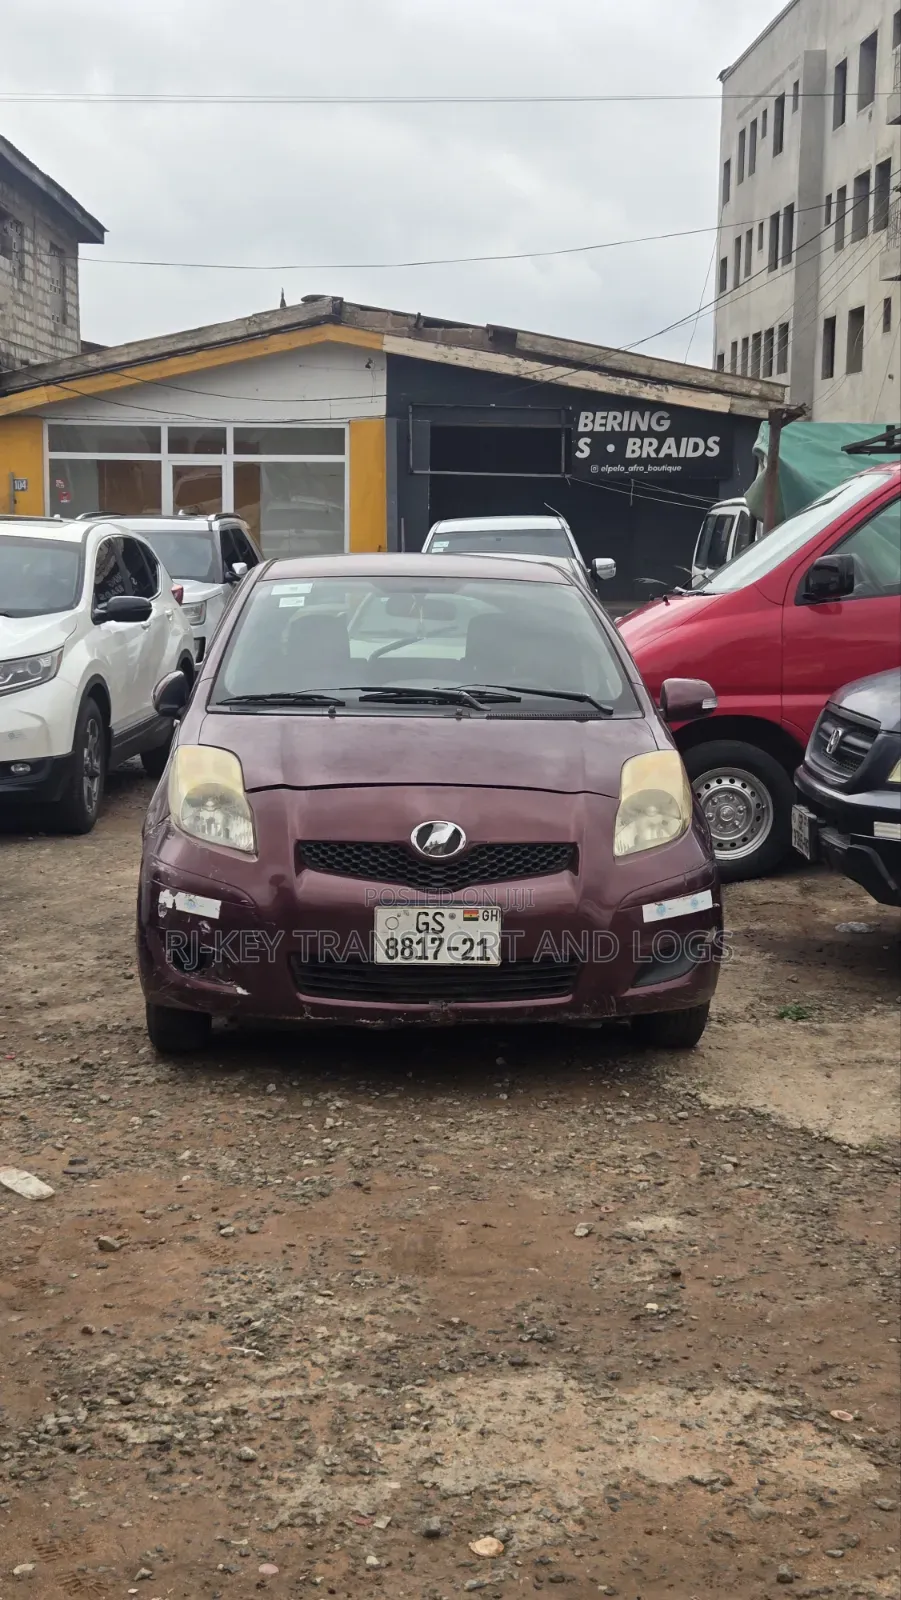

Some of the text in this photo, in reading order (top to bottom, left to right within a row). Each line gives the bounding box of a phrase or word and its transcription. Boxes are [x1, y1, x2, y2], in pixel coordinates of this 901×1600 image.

[577, 410, 671, 432] BERING
[574, 435, 721, 459] S BRAIDS
[14, 480, 26, 490] 104
[415, 909, 498, 934] GS GH
[385, 937, 491, 961] 8817-21
